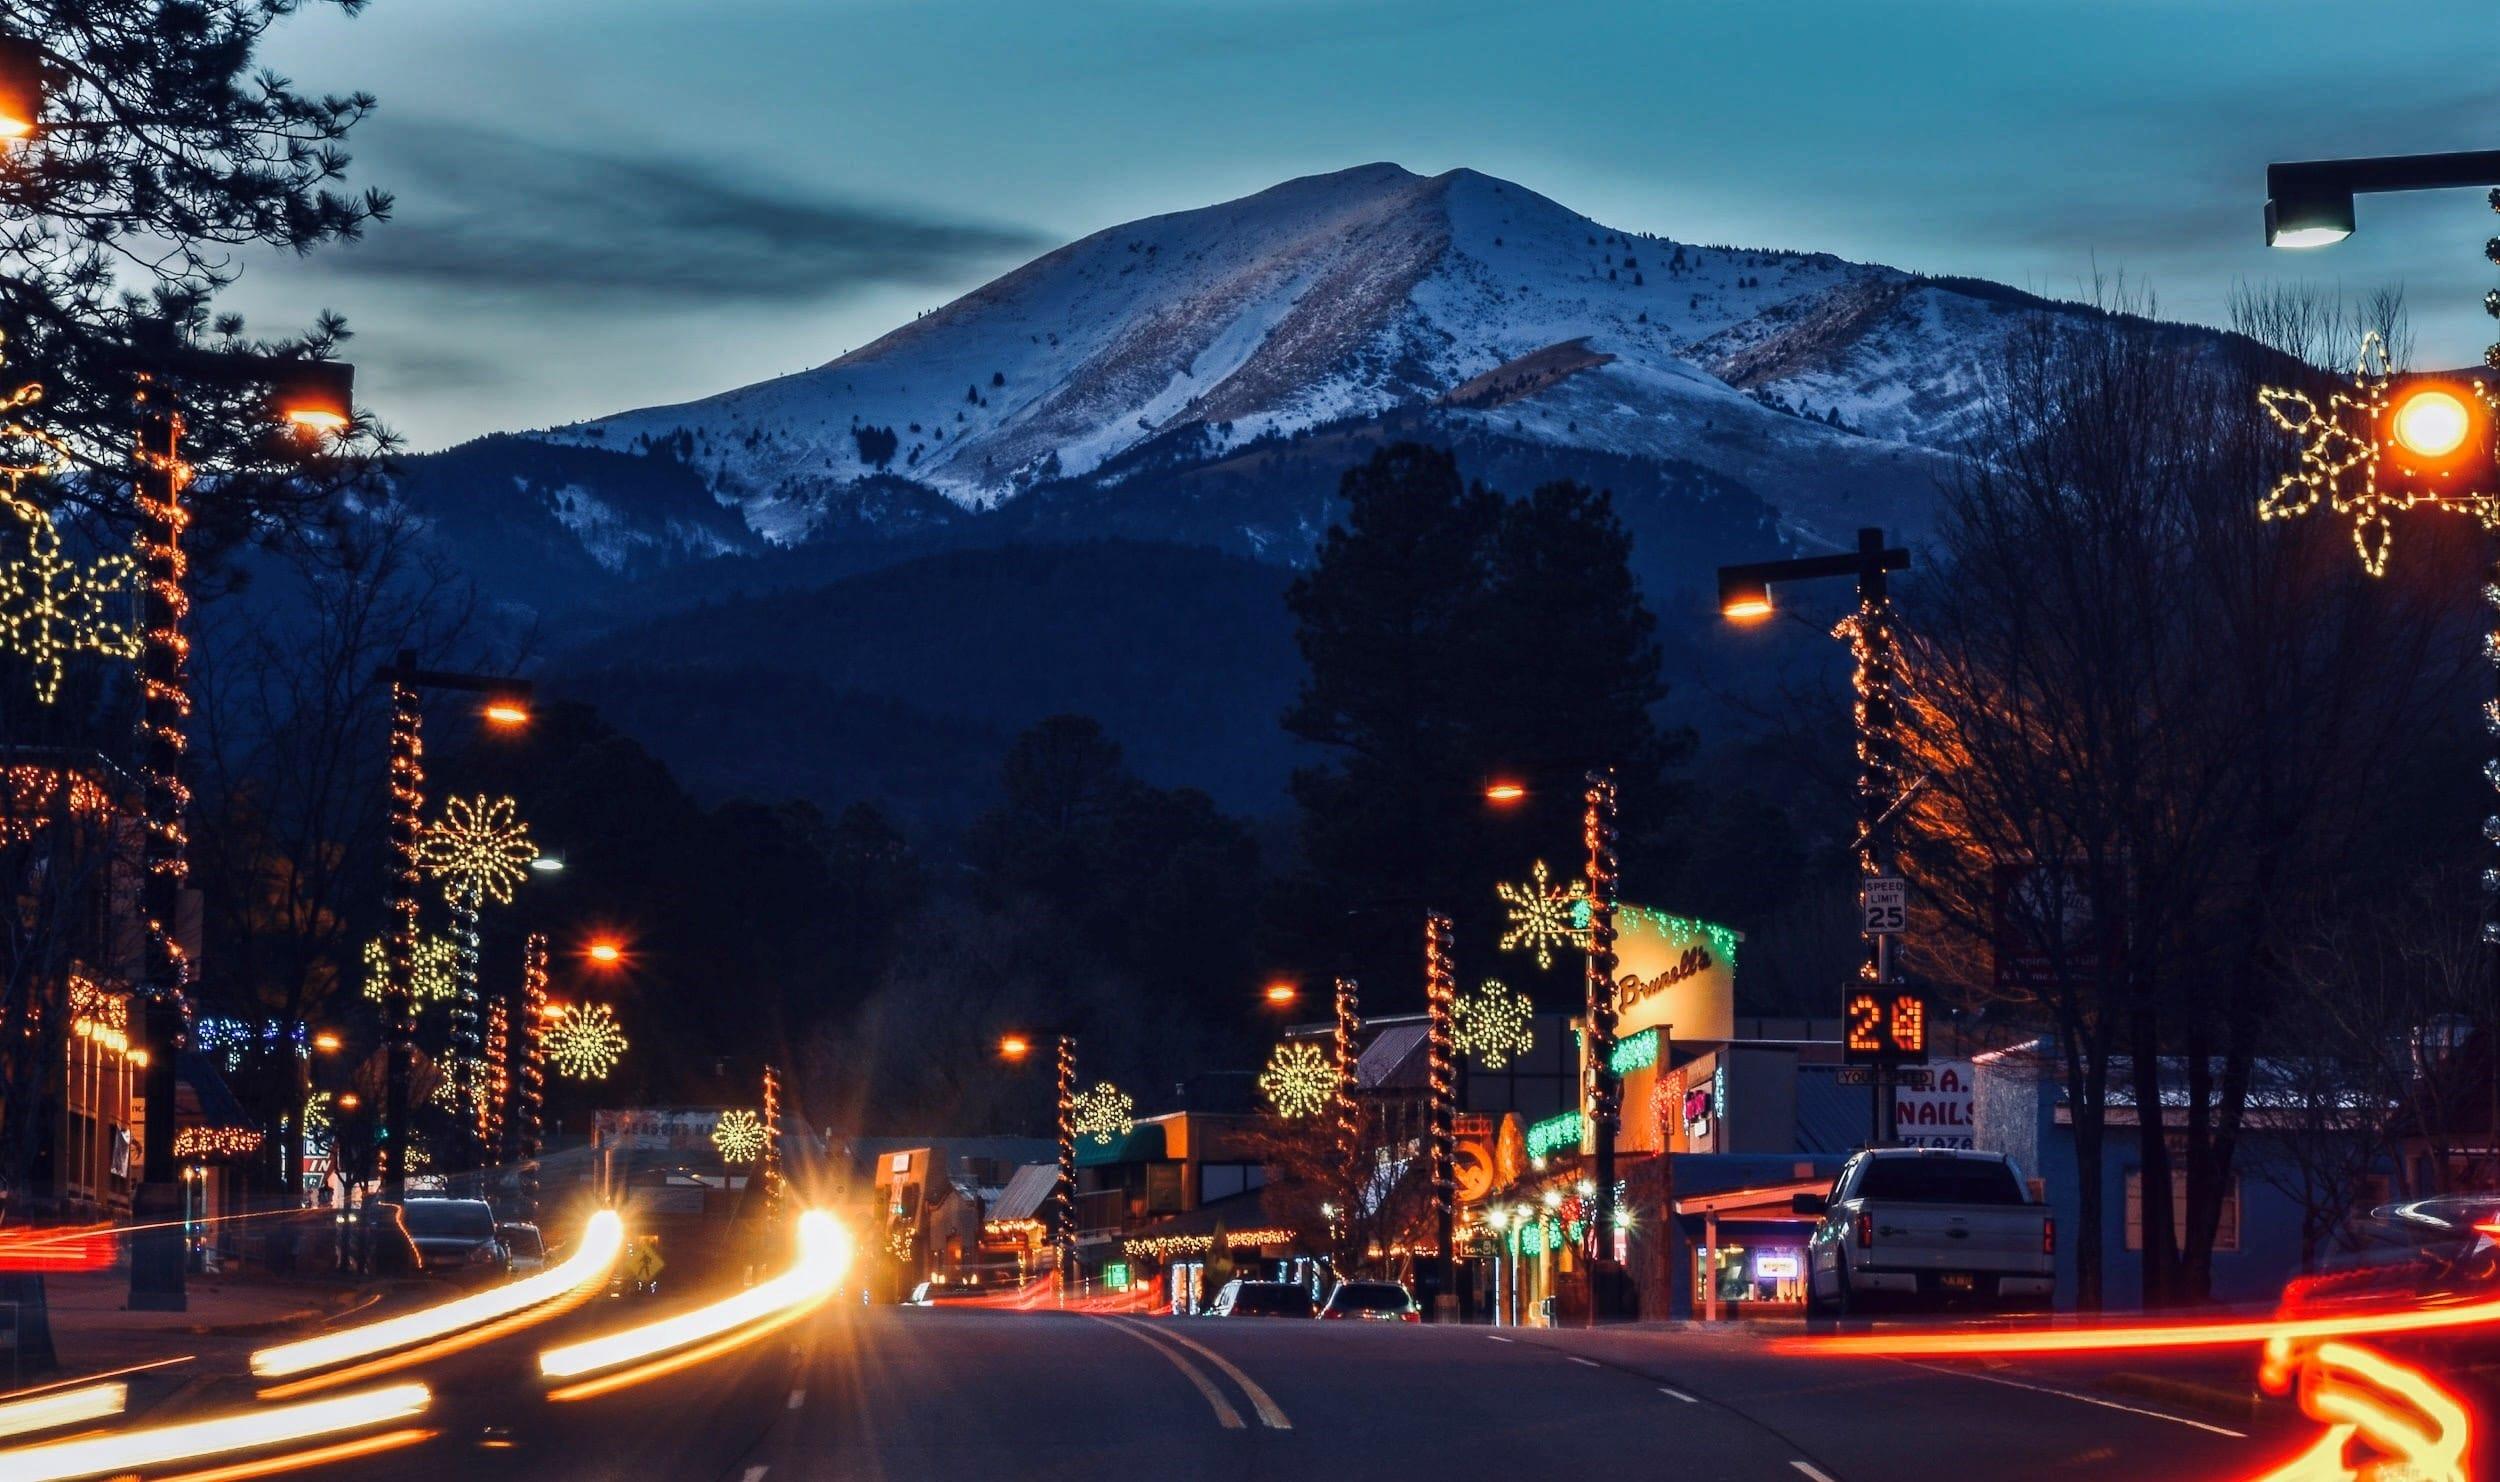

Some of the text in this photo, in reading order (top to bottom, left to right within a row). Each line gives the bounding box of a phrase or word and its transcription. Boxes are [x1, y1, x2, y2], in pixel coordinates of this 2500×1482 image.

[1867, 882, 1903, 892] SPEED
[1871, 894, 1899, 904] LIMIT
[1868, 907, 1903, 928] 25
[1619, 946, 1712, 1014] Brunell's
[1888, 1071, 1928, 1083] PEED
[1898, 1102, 1973, 1125] NAILS
[1905, 1137, 1972, 1148] PLAZA
